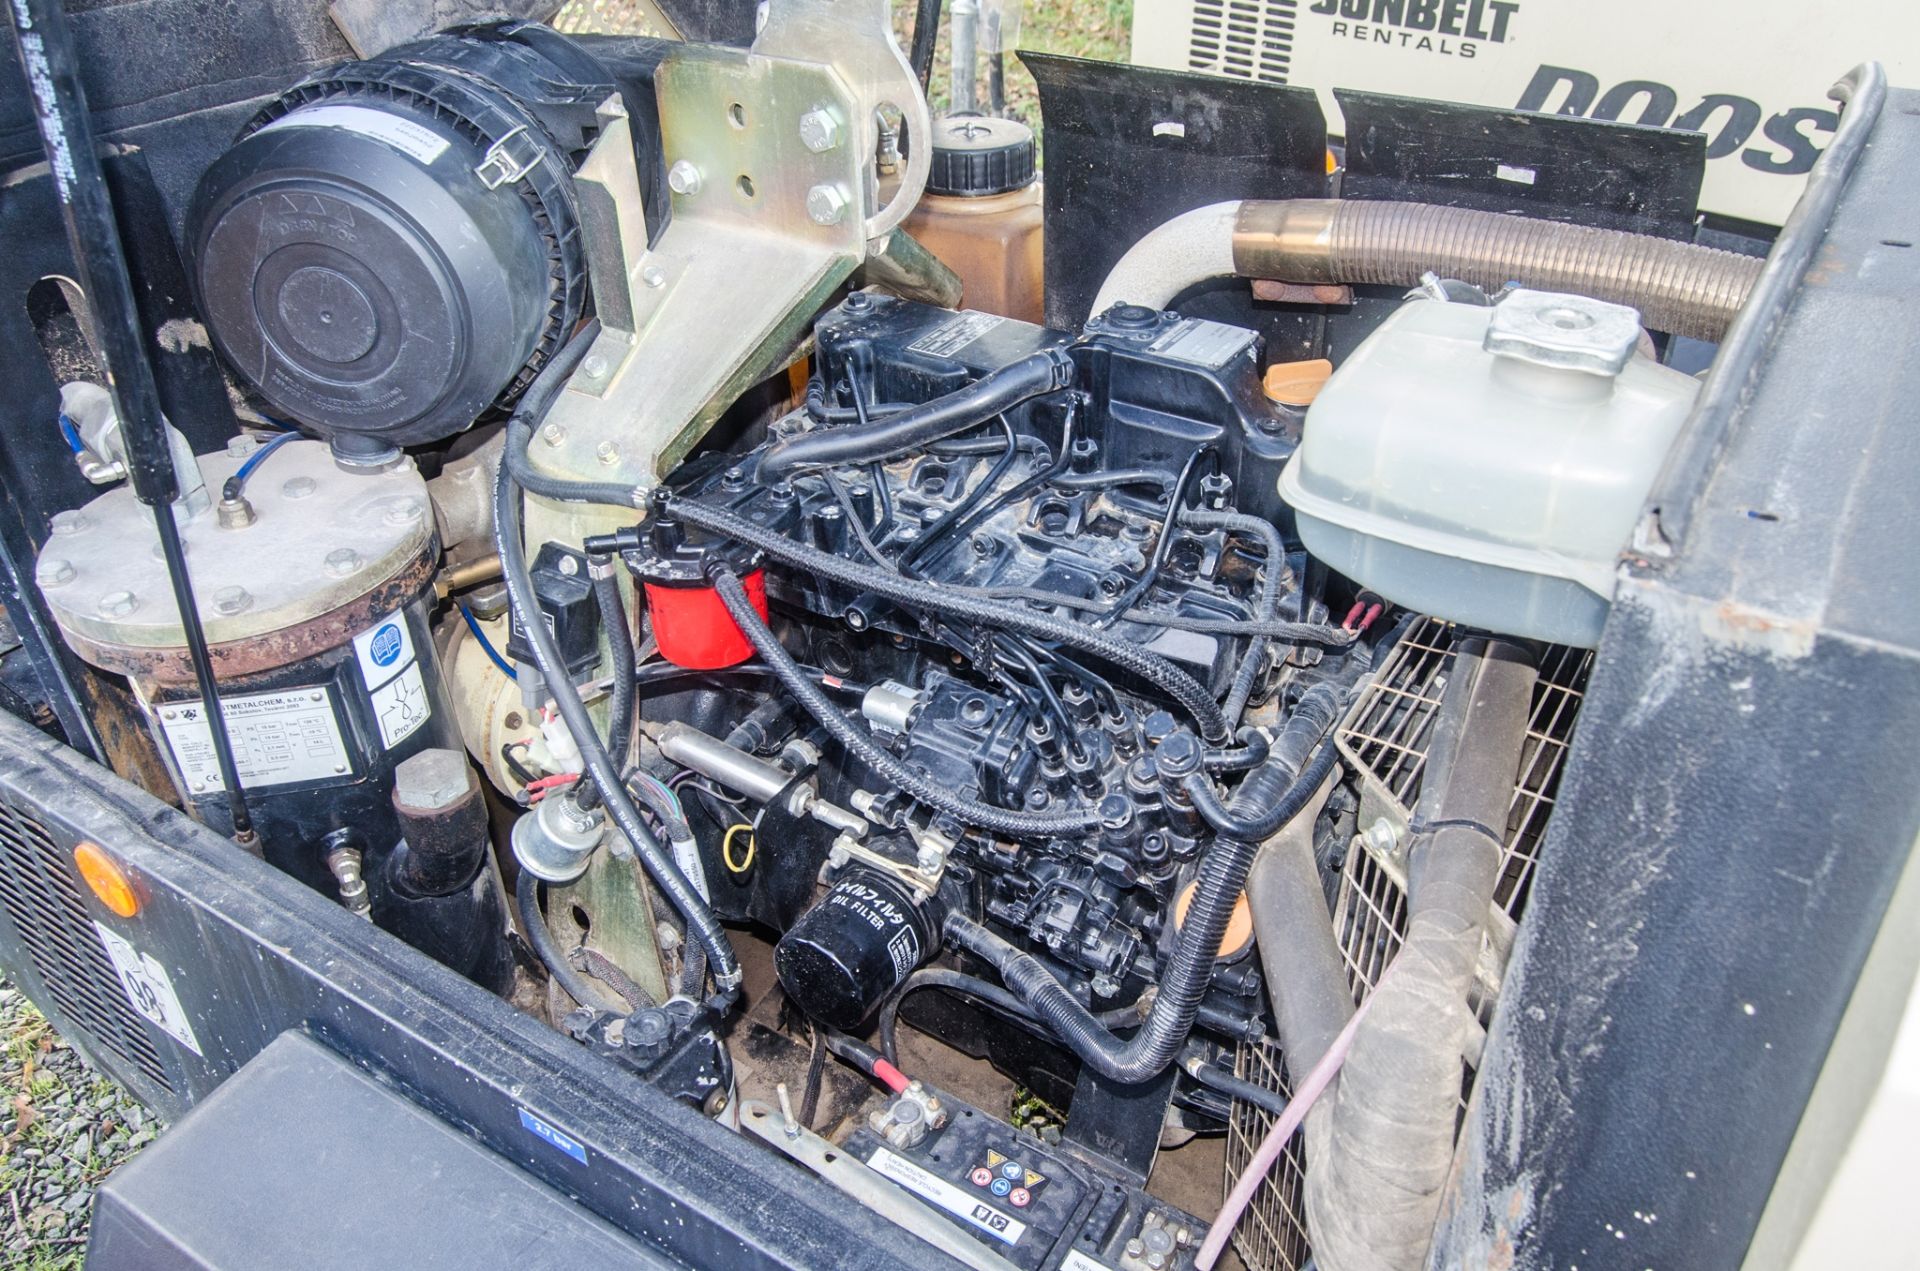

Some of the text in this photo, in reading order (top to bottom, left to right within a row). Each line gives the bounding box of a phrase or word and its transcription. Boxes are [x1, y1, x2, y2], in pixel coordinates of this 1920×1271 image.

[1332, 21, 1477, 58] RENTALS
[1514, 64, 1838, 175] DOOS
[394, 712, 423, 738] Pro-Tec
[590, 762, 612, 797] SEMPERIT
[832, 895, 885, 931] OIL FILTER
